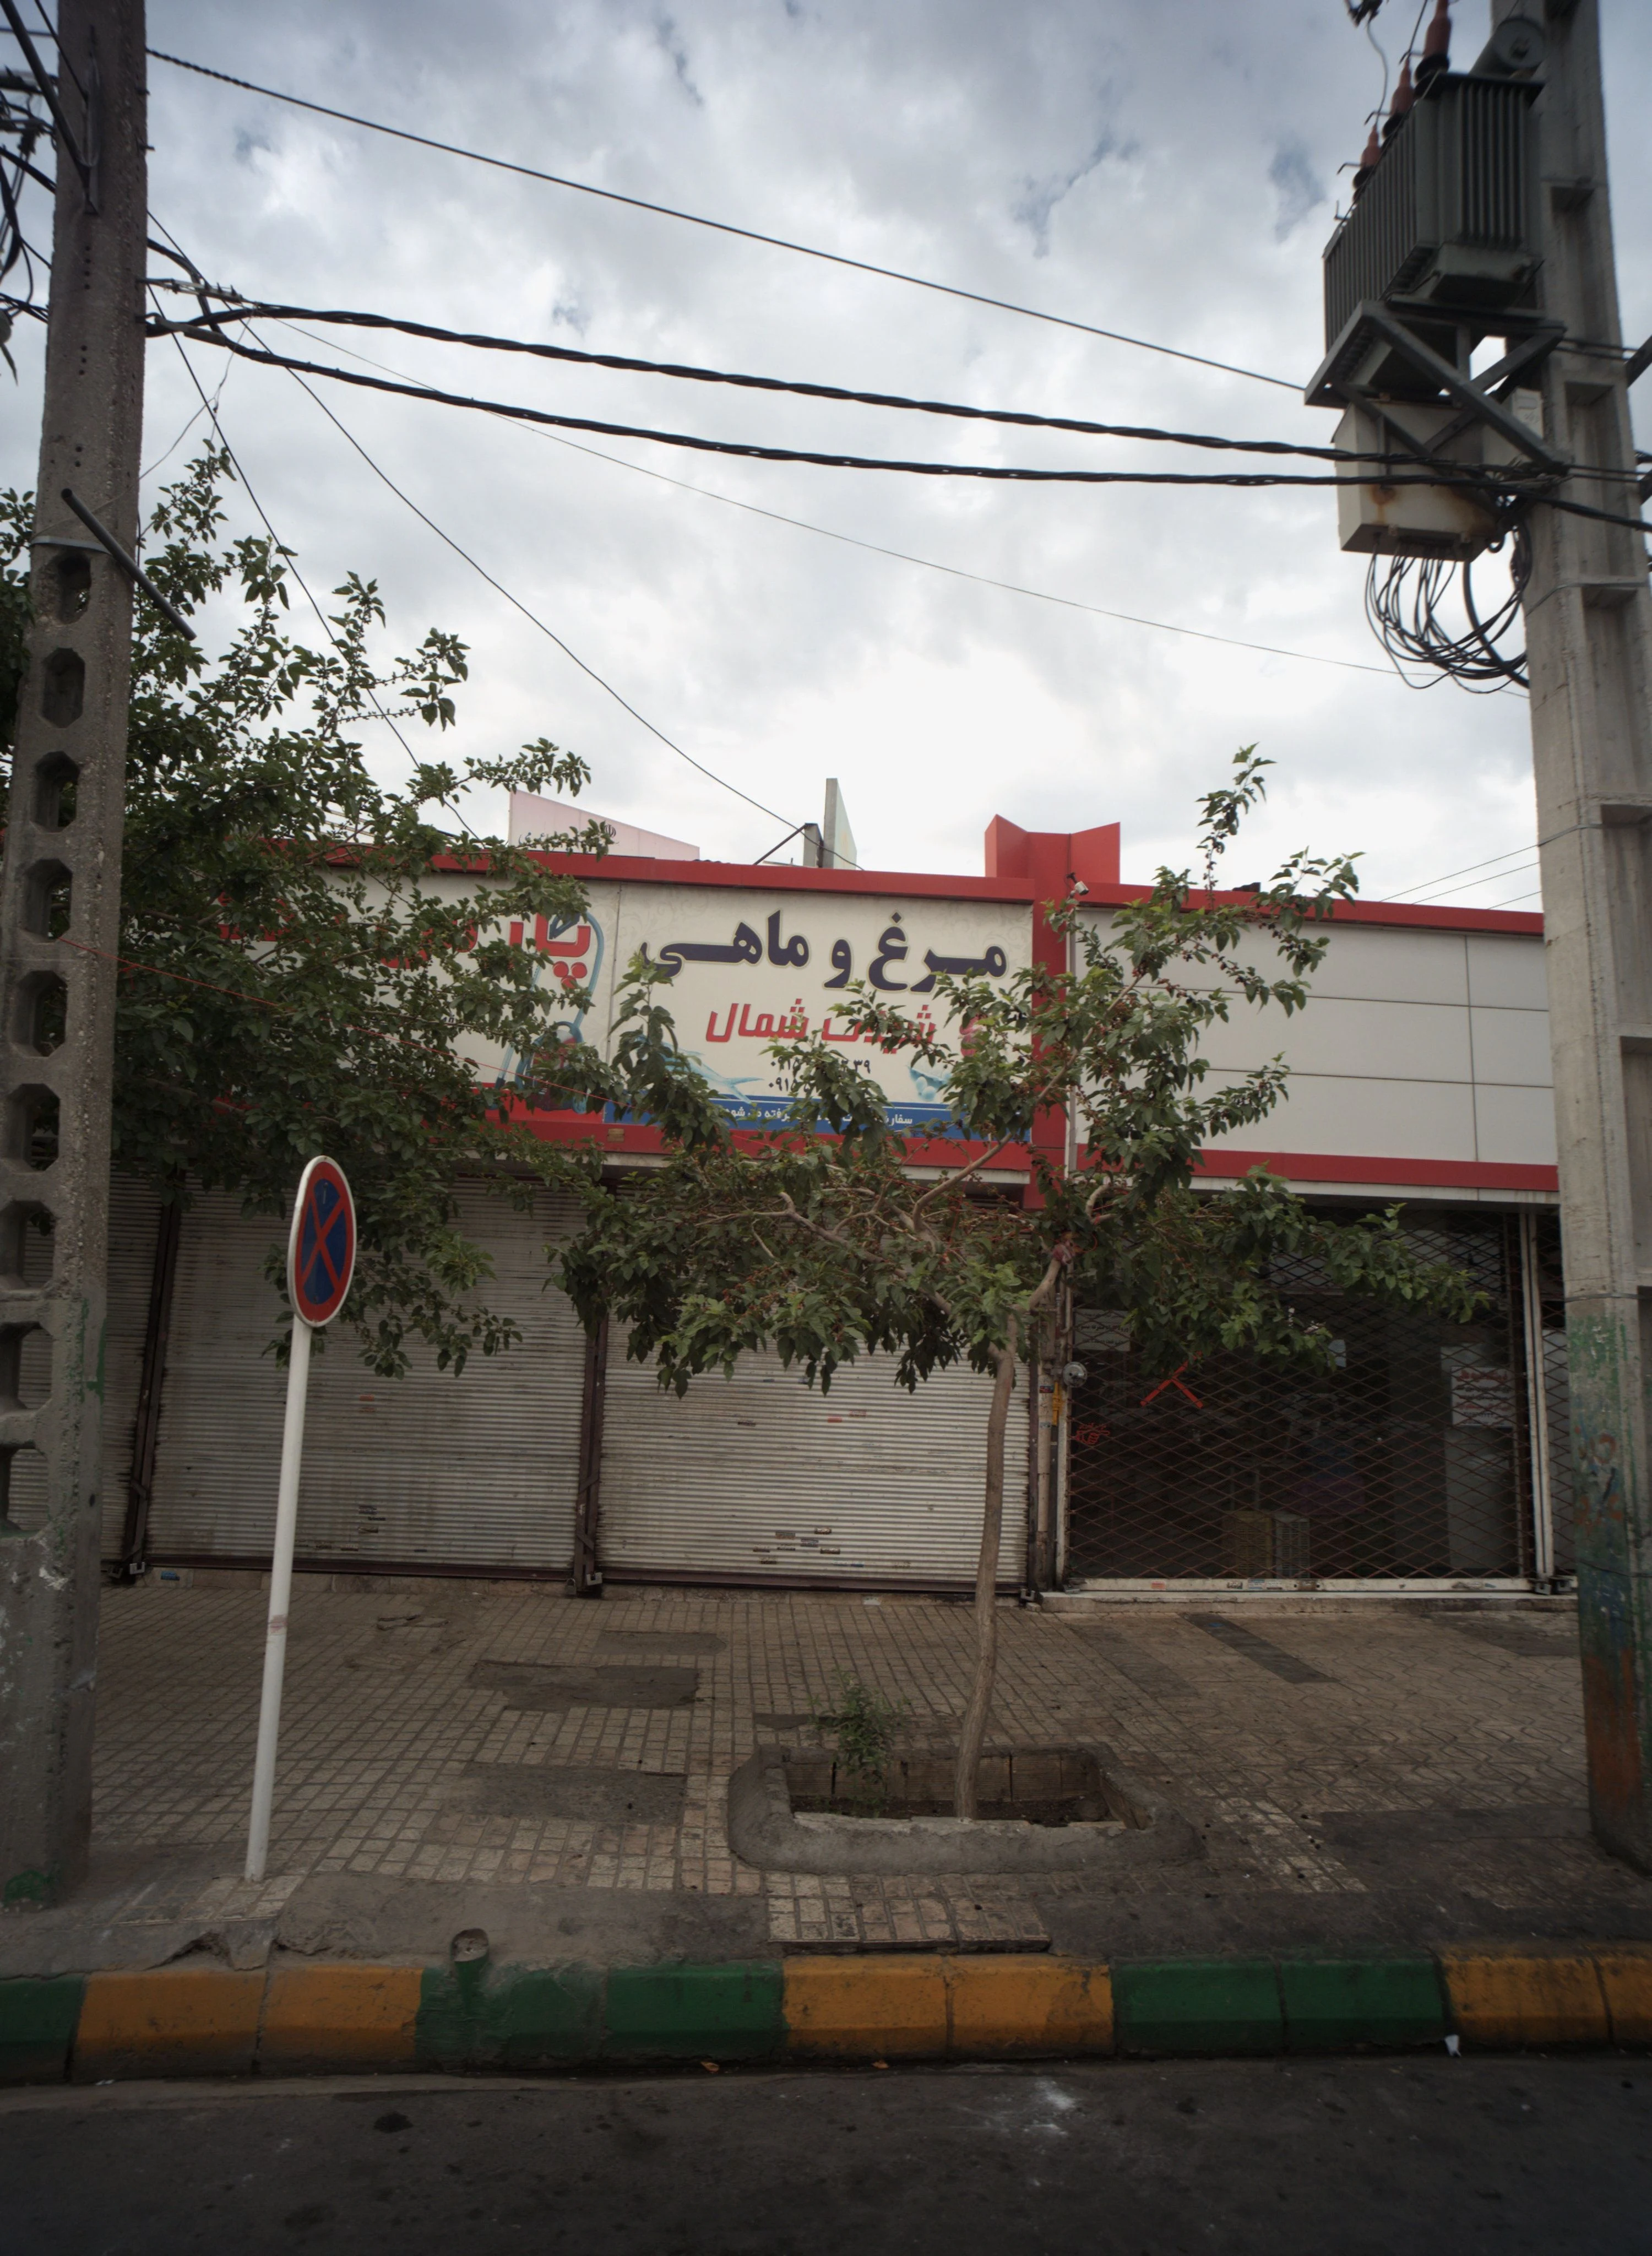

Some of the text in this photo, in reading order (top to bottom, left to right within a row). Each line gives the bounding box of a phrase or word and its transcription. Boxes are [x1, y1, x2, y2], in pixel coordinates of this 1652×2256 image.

[640, 909, 1008, 993] مرغ و ماهی
[705, 999, 936, 1054] شیت شمال
